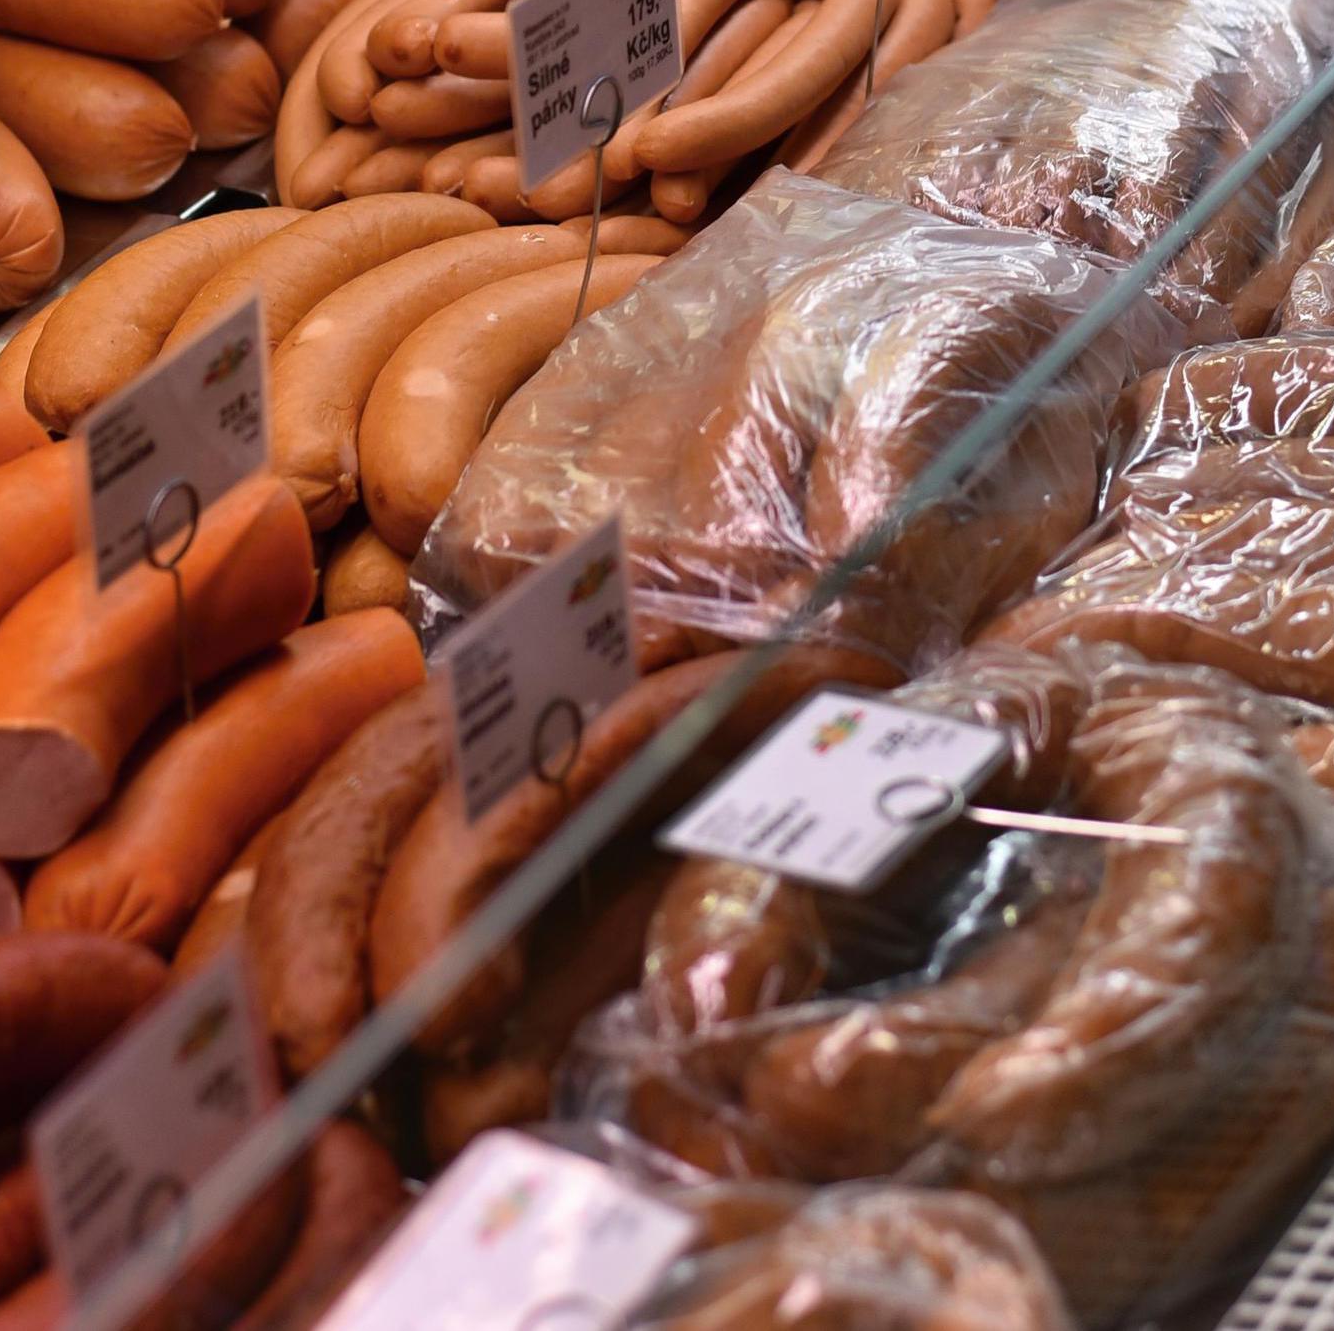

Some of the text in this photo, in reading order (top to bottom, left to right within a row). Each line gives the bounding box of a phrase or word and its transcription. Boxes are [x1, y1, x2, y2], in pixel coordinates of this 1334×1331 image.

[626, 18, 672, 64] Kč/kg
[527, 50, 571, 98] Silné
[531, 84, 578, 140] párky
